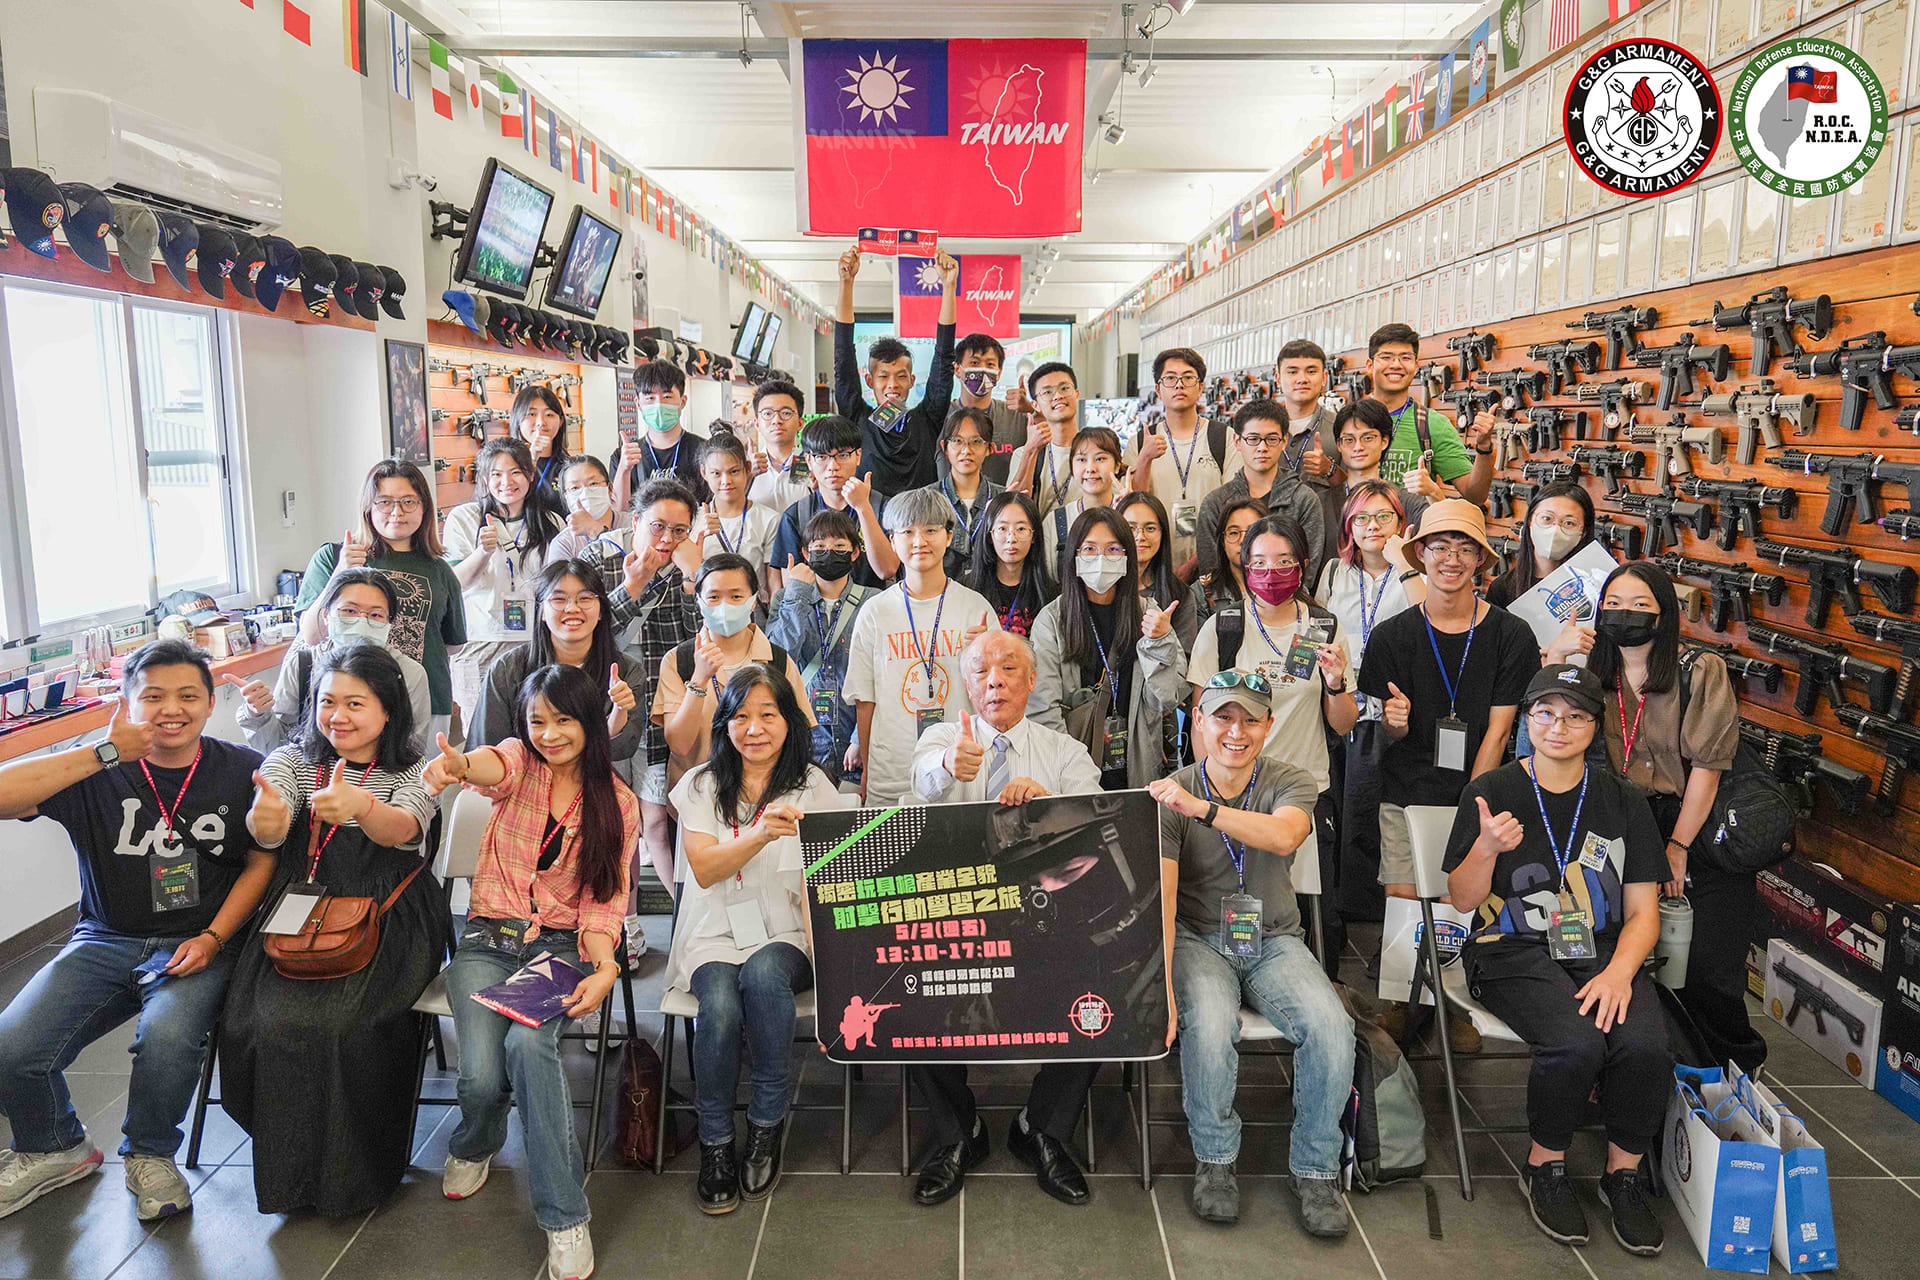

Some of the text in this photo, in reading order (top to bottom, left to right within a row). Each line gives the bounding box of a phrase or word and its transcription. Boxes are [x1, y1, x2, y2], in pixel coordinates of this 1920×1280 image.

[960, 122, 1070, 146] TAIWAN
[965, 289, 1014, 301] TAIWAN
[886, 629, 964, 661] NIRVANA
[113, 798, 226, 858] Lee
[832, 885, 1022, 931] 射擊行動學習之旅
[895, 918, 987, 941] 5/3(週五)
[875, 940, 1012, 964] 13:10-17:00
